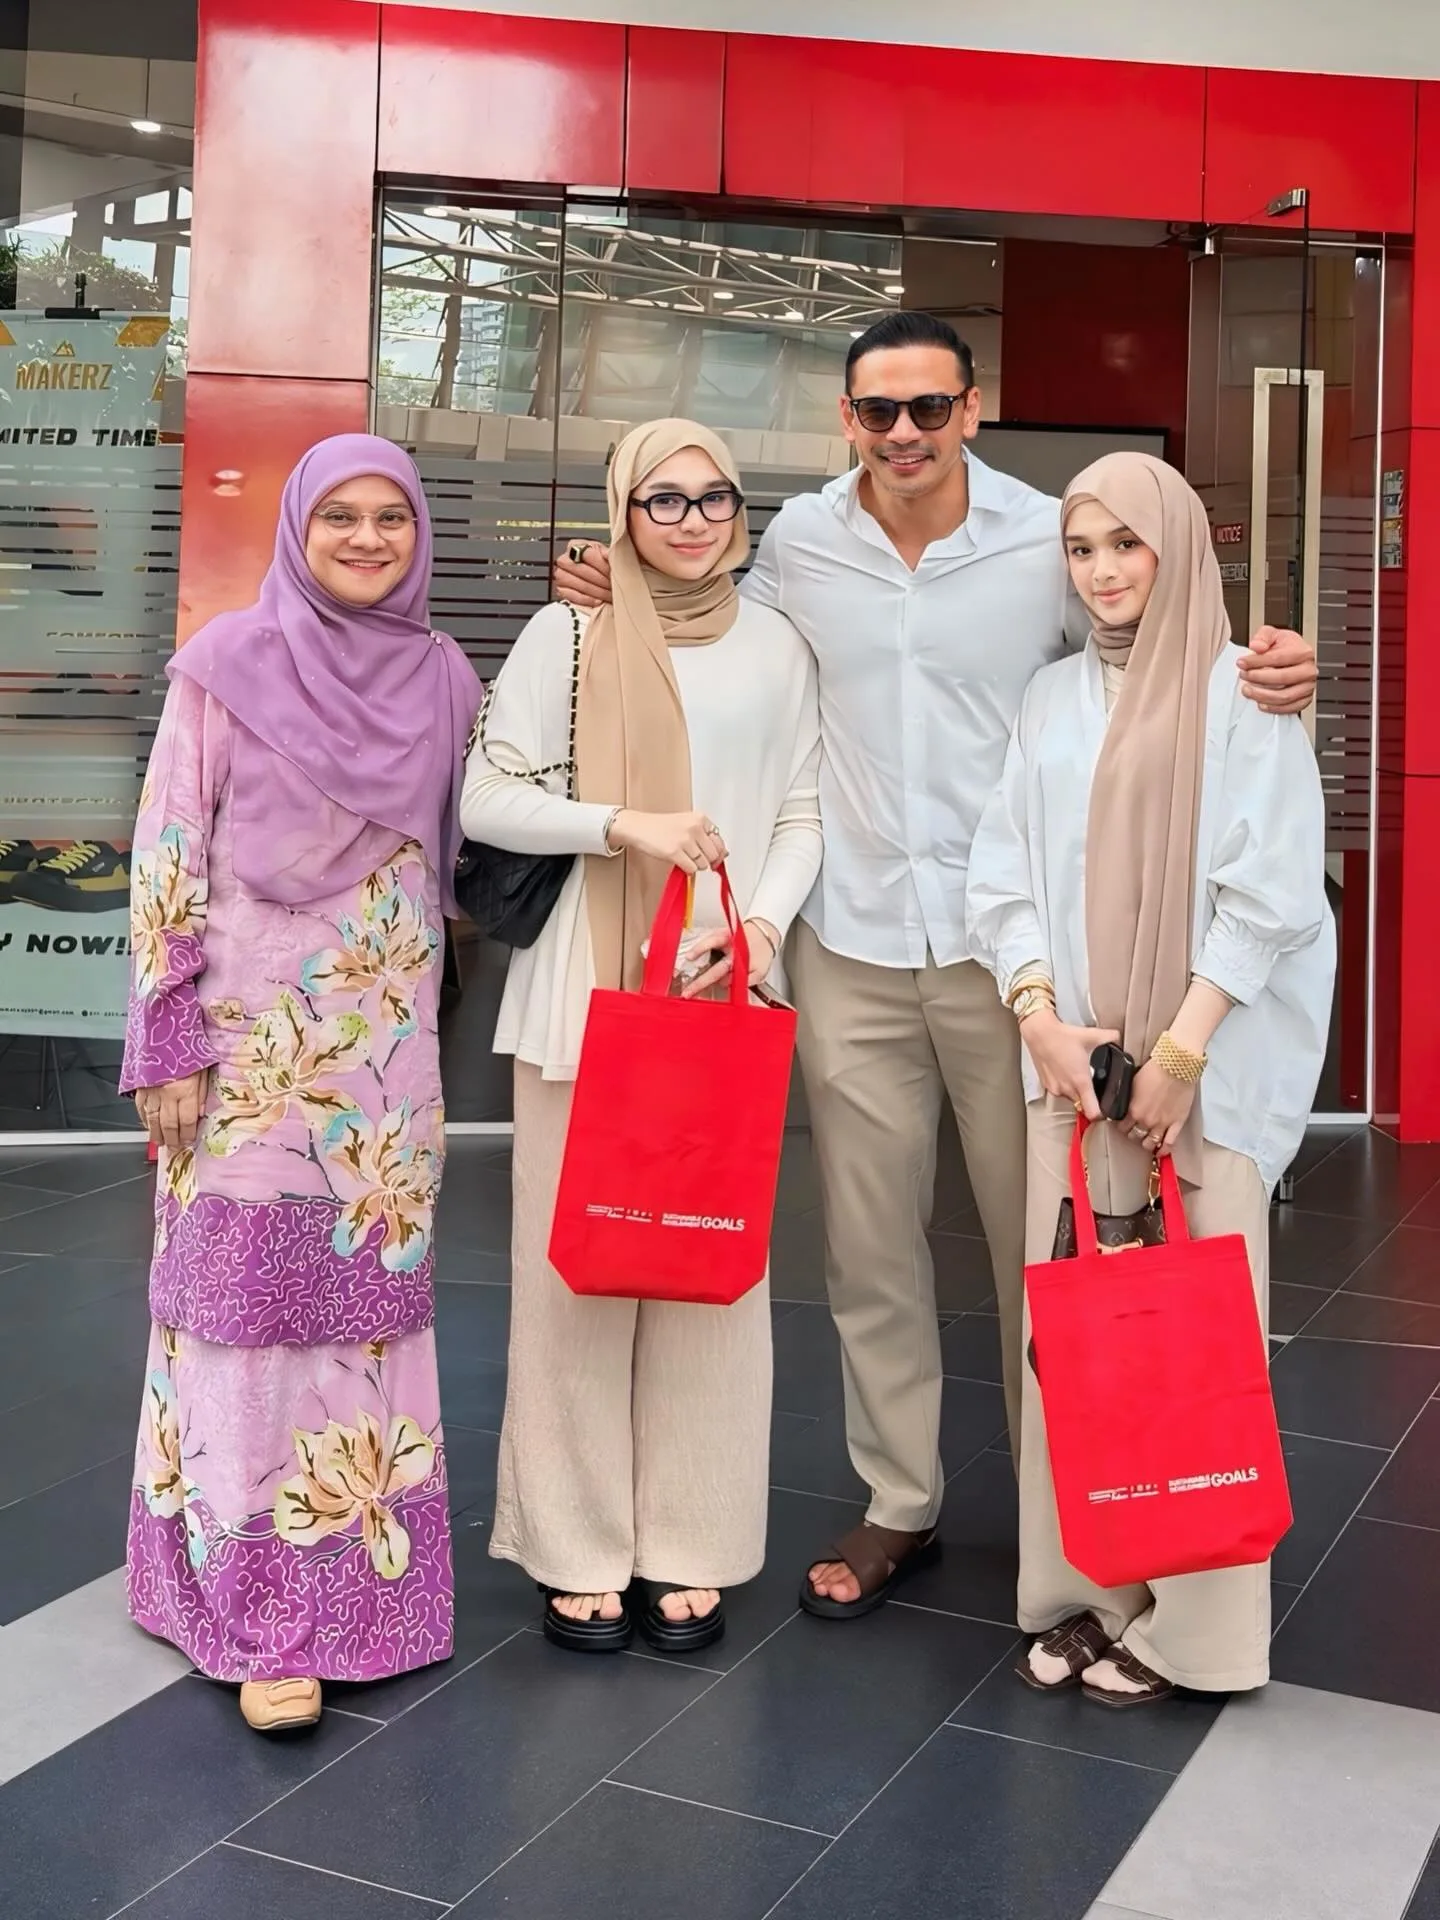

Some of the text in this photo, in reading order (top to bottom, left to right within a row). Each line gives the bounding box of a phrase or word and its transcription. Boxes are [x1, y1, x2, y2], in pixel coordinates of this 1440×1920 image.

[16, 363, 112, 390] MAKERZ
[92, 429, 158, 447] TIME
[702, 1216, 745, 1231] GOALS
[1211, 1466, 1259, 1487] GOALS
